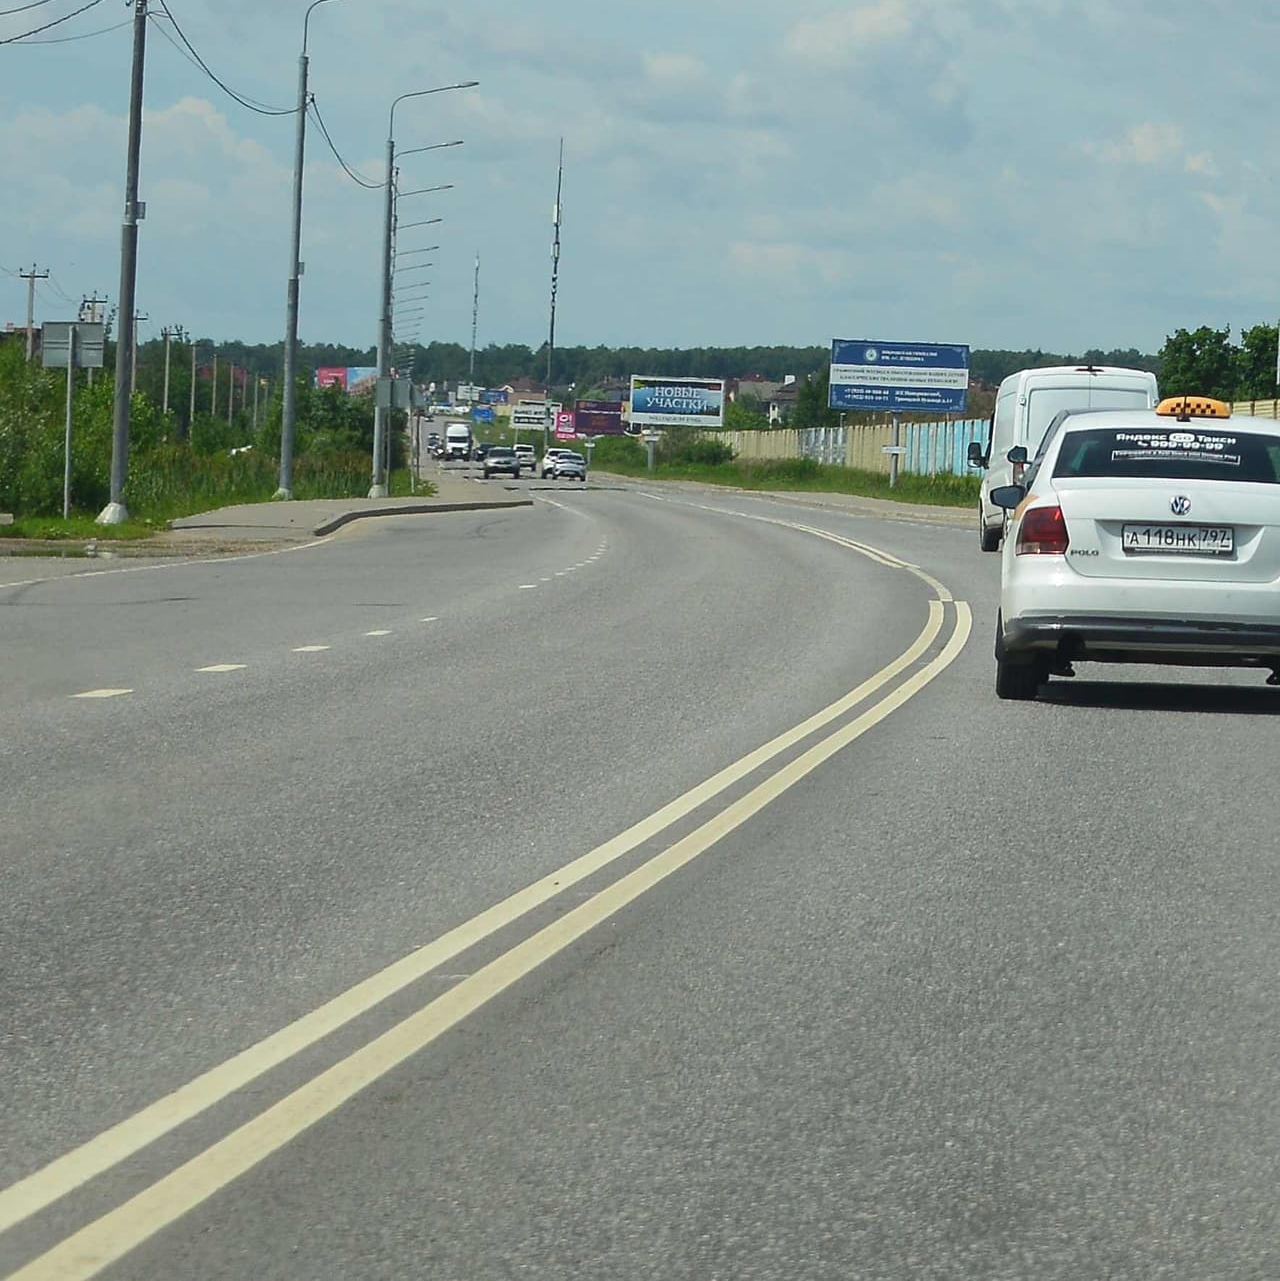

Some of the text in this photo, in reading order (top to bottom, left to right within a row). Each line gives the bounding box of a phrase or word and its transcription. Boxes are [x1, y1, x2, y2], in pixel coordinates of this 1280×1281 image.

[655, 386, 701, 399] НОВЫЕ
[647, 397, 707, 410] УЧАСТКИ
[1116, 433, 1167, 442] Яндекс
[1197, 434, 1236, 444] Такси
